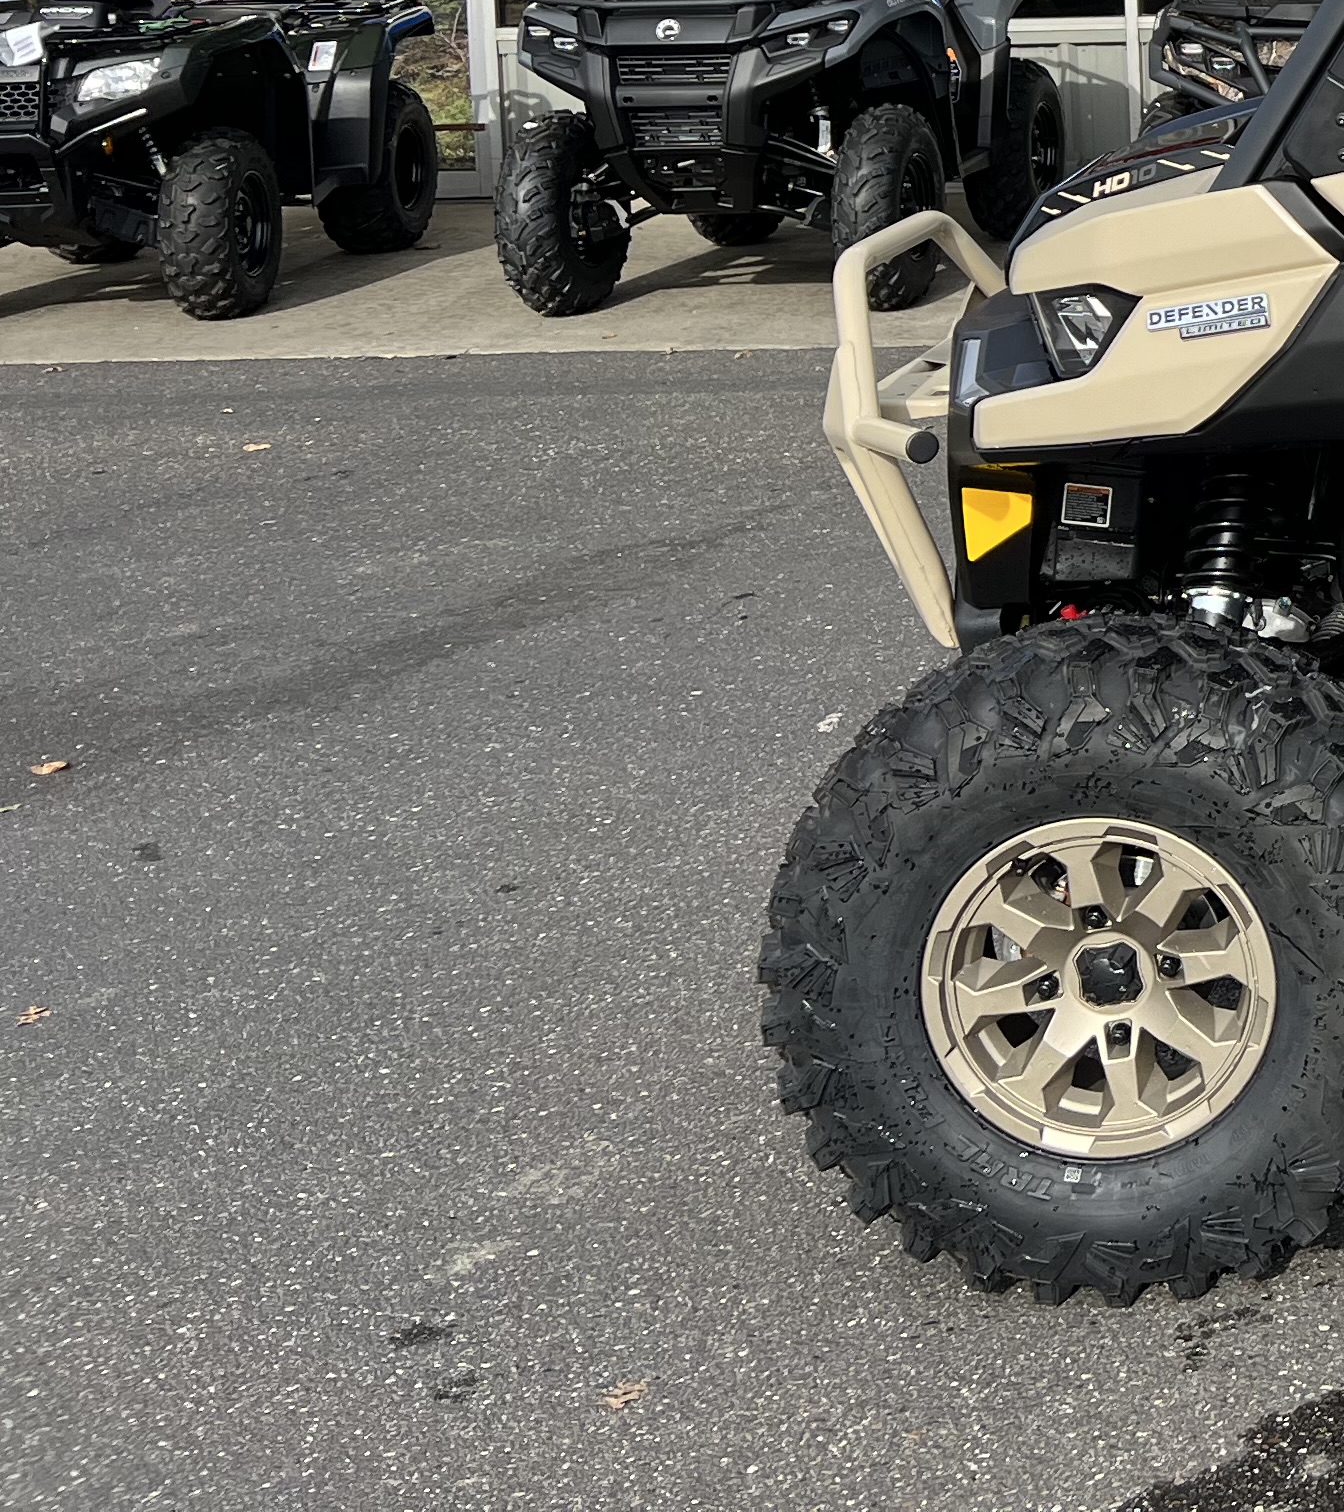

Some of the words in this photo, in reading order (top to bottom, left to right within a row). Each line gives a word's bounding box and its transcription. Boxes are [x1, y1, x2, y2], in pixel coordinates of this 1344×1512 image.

[1092, 163, 1157, 198] HD10
[1148, 295, 1265, 326] DEFENDER
[1185, 317, 1262, 335] LIMITED
